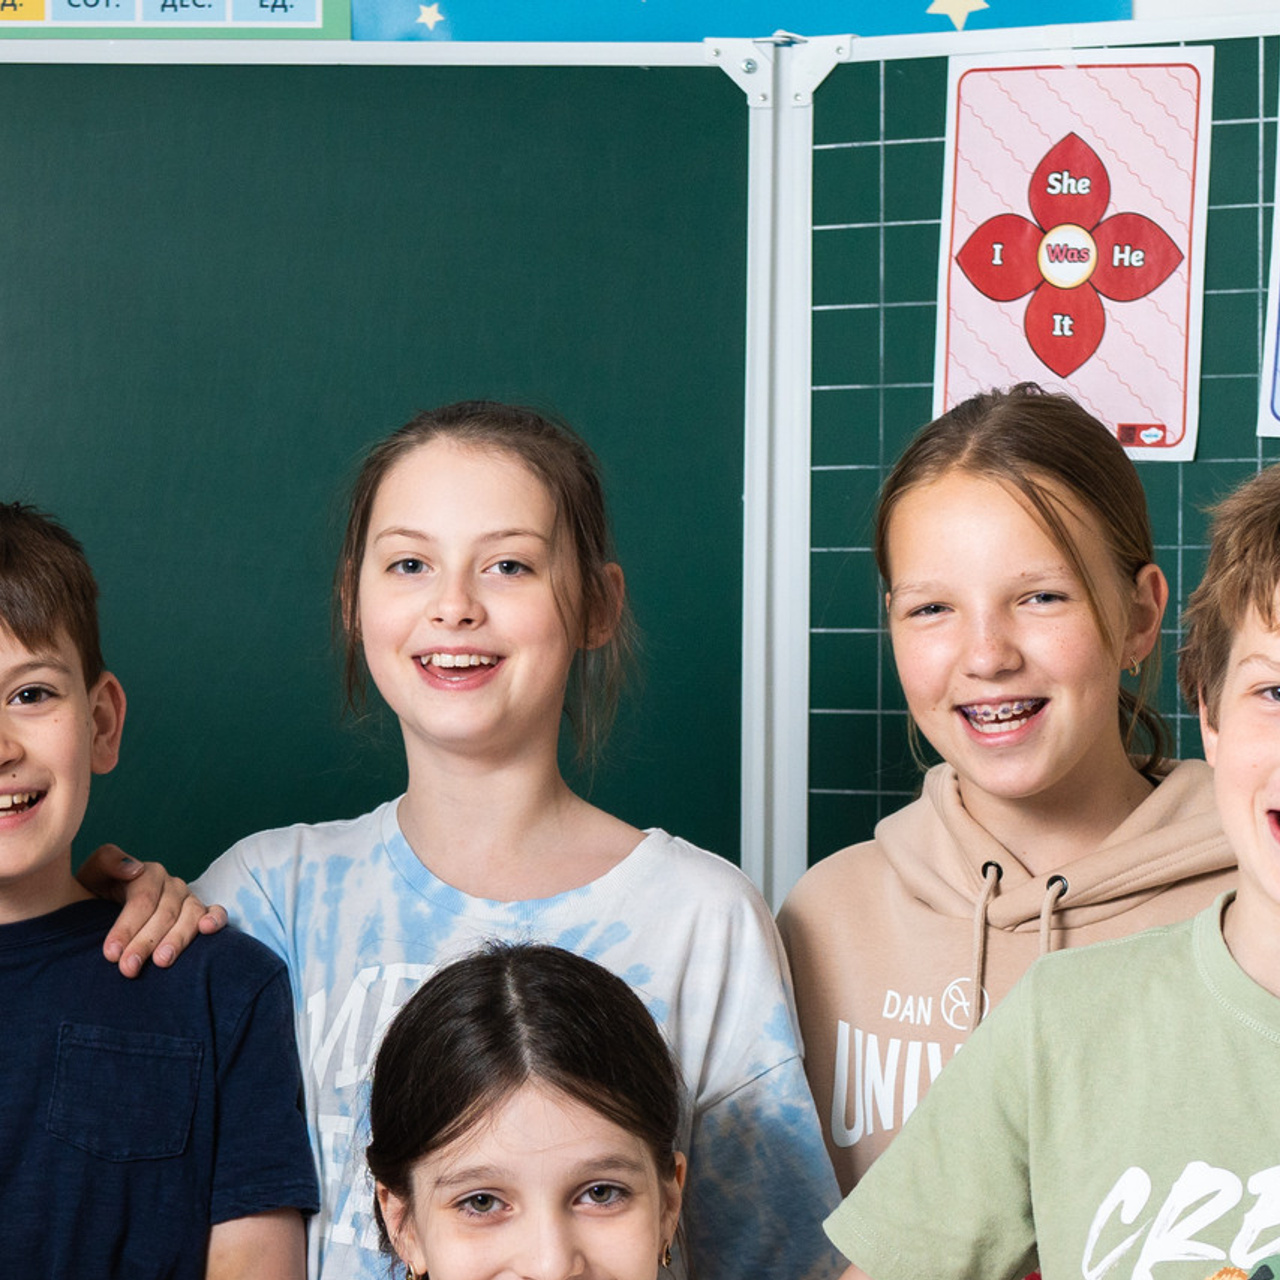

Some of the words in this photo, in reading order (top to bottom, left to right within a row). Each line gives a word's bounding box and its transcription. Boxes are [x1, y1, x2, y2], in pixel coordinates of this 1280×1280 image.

[1046, 169, 1091, 195] She
[992, 243, 1004, 266] I
[1046, 243, 1090, 263] Was
[1112, 244, 1145, 267] He
[1052, 313, 1074, 337] It
[882, 989, 933, 1027] DAN
